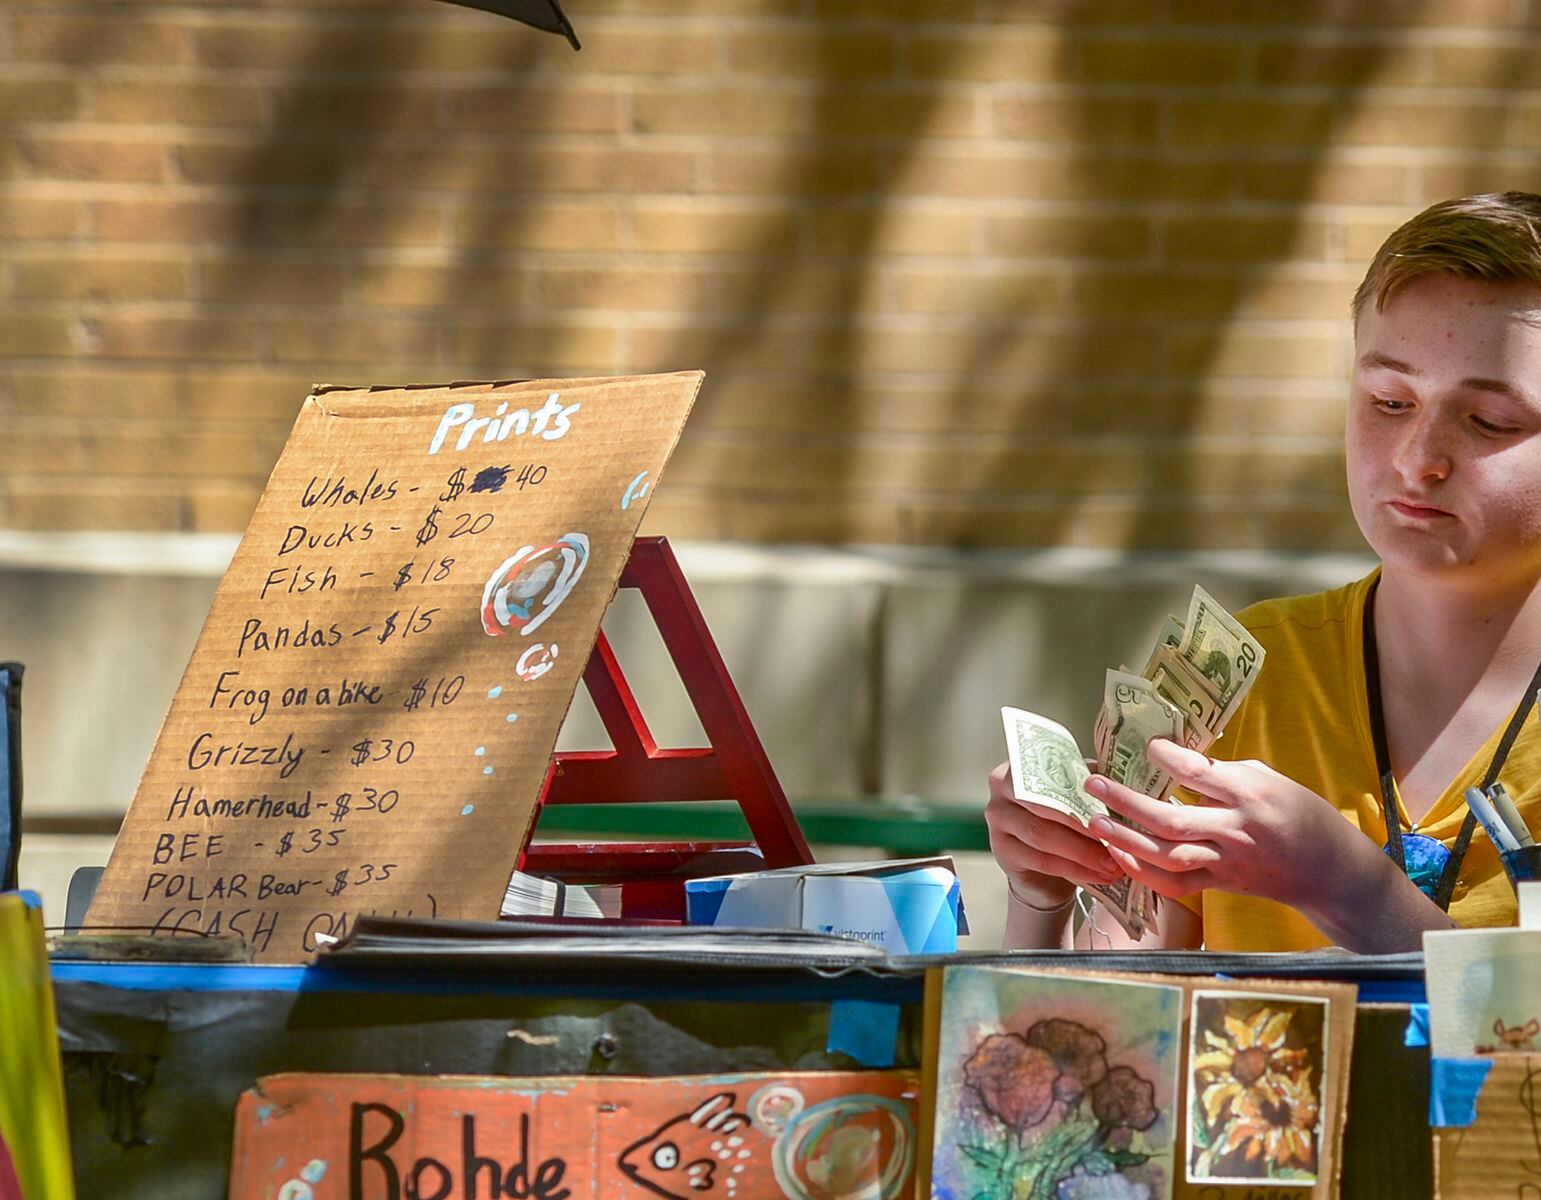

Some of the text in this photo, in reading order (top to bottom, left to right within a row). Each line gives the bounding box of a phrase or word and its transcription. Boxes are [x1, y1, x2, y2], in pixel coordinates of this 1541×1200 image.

[429, 393, 581, 455] Prints
[301, 469, 398, 508] Whales
[278, 522, 374, 557] Ducks
[260, 565, 337, 600] Fish
[393, 556, 456, 592] $18
[237, 618, 343, 659] Pandas
[377, 604, 442, 645] $15
[1236, 641, 1257, 680] 20
[208, 670, 271, 726] Frog
[281, 687, 308, 708] on
[315, 687, 331, 707] a
[403, 675, 465, 712] $10
[187, 732, 304, 780] Grizzly
[351, 738, 415, 767] $30
[153, 832, 224, 866] BEE
[142, 871, 249, 902] POLAR
